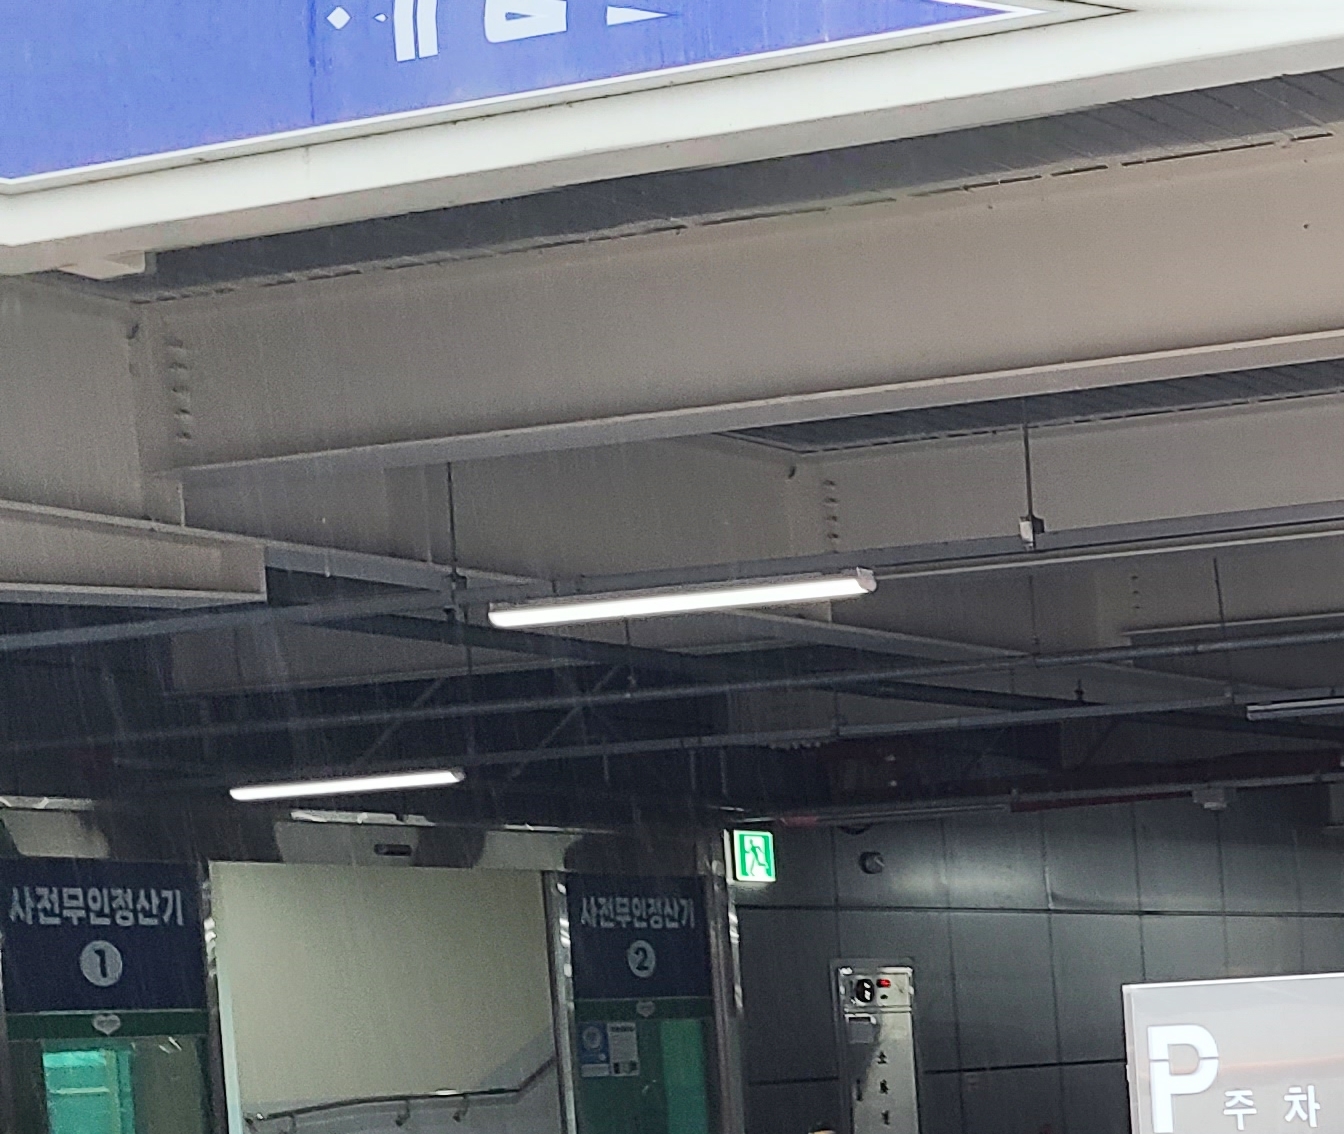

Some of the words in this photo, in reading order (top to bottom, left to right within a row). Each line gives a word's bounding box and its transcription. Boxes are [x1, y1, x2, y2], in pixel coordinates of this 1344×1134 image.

[8, 885, 185, 927] 사전무인정산기
[580, 896, 695, 929] 사전무인정산기
[1146, 1024, 1220, 1134] P
